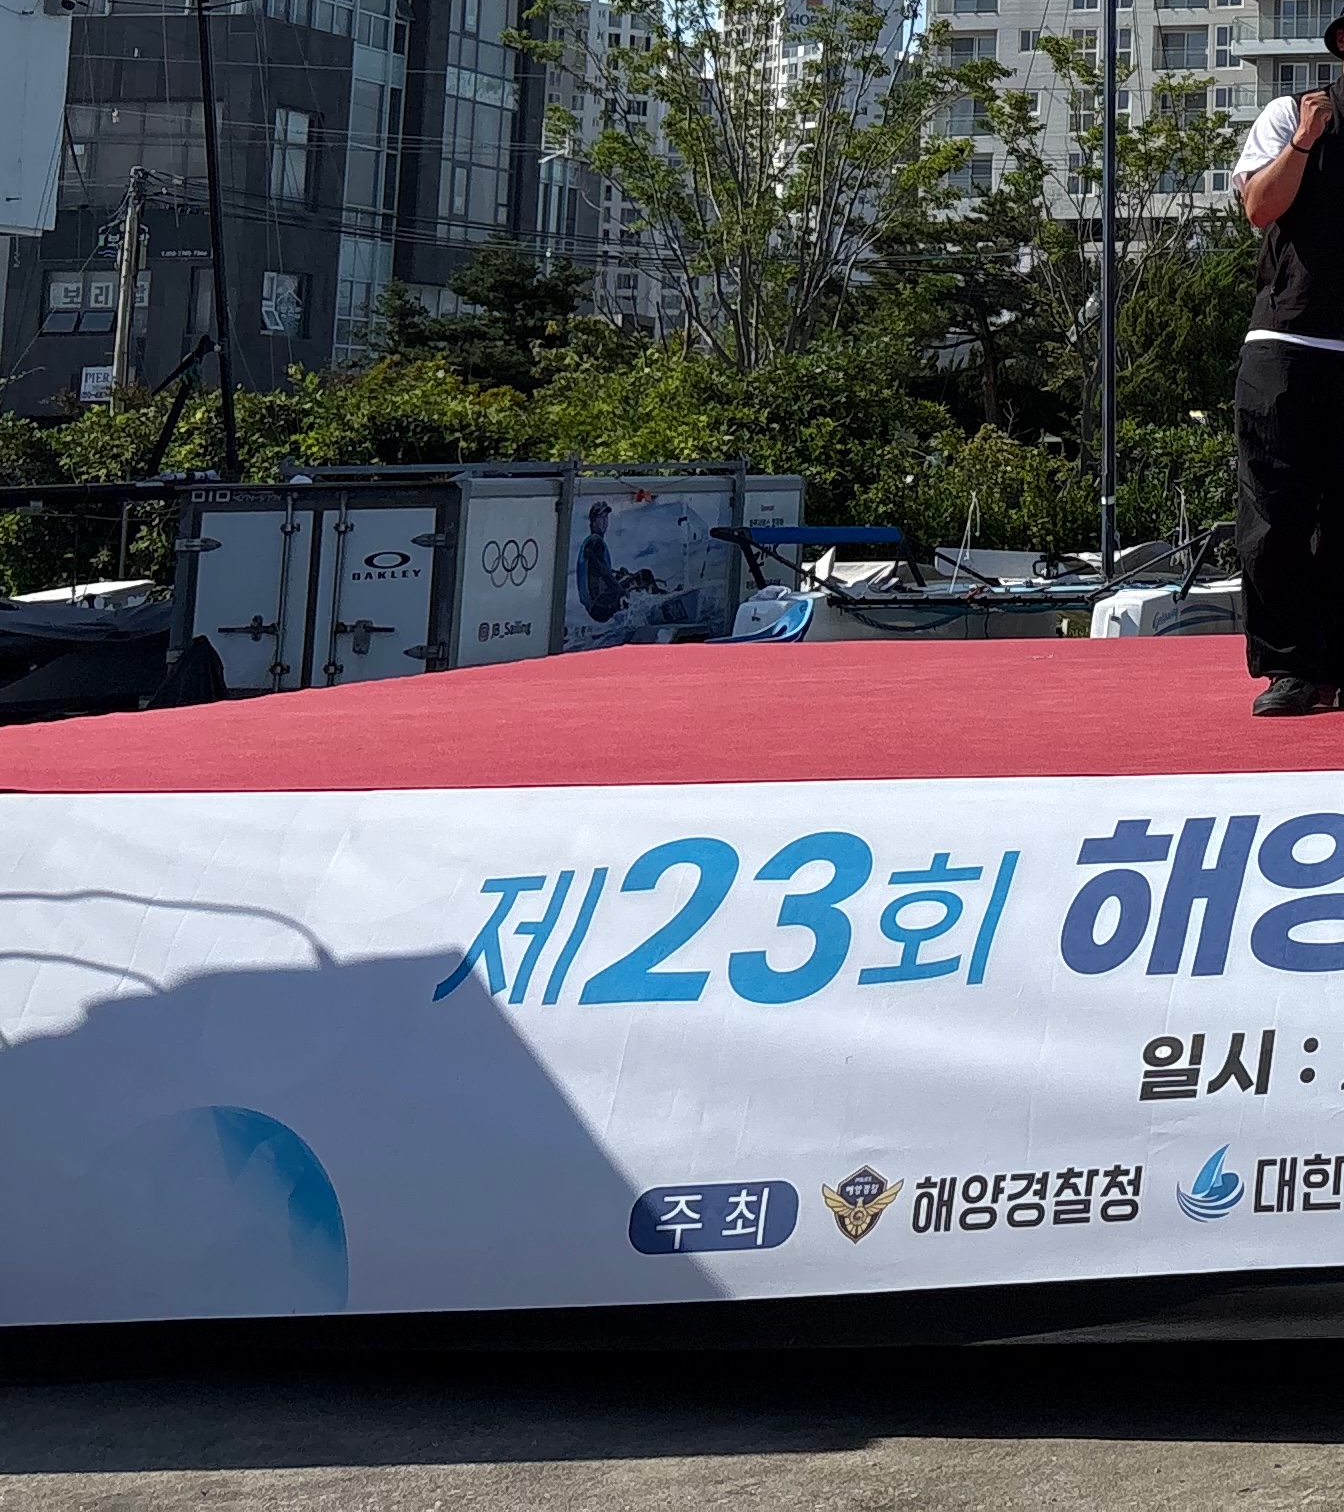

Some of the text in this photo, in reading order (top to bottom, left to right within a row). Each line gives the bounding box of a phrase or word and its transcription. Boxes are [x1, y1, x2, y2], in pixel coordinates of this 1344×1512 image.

[352, 569, 422, 580] OAKLEY
[432, 831, 1020, 1006] 제23회
[911, 1164, 1143, 1234] 해양경찰청
